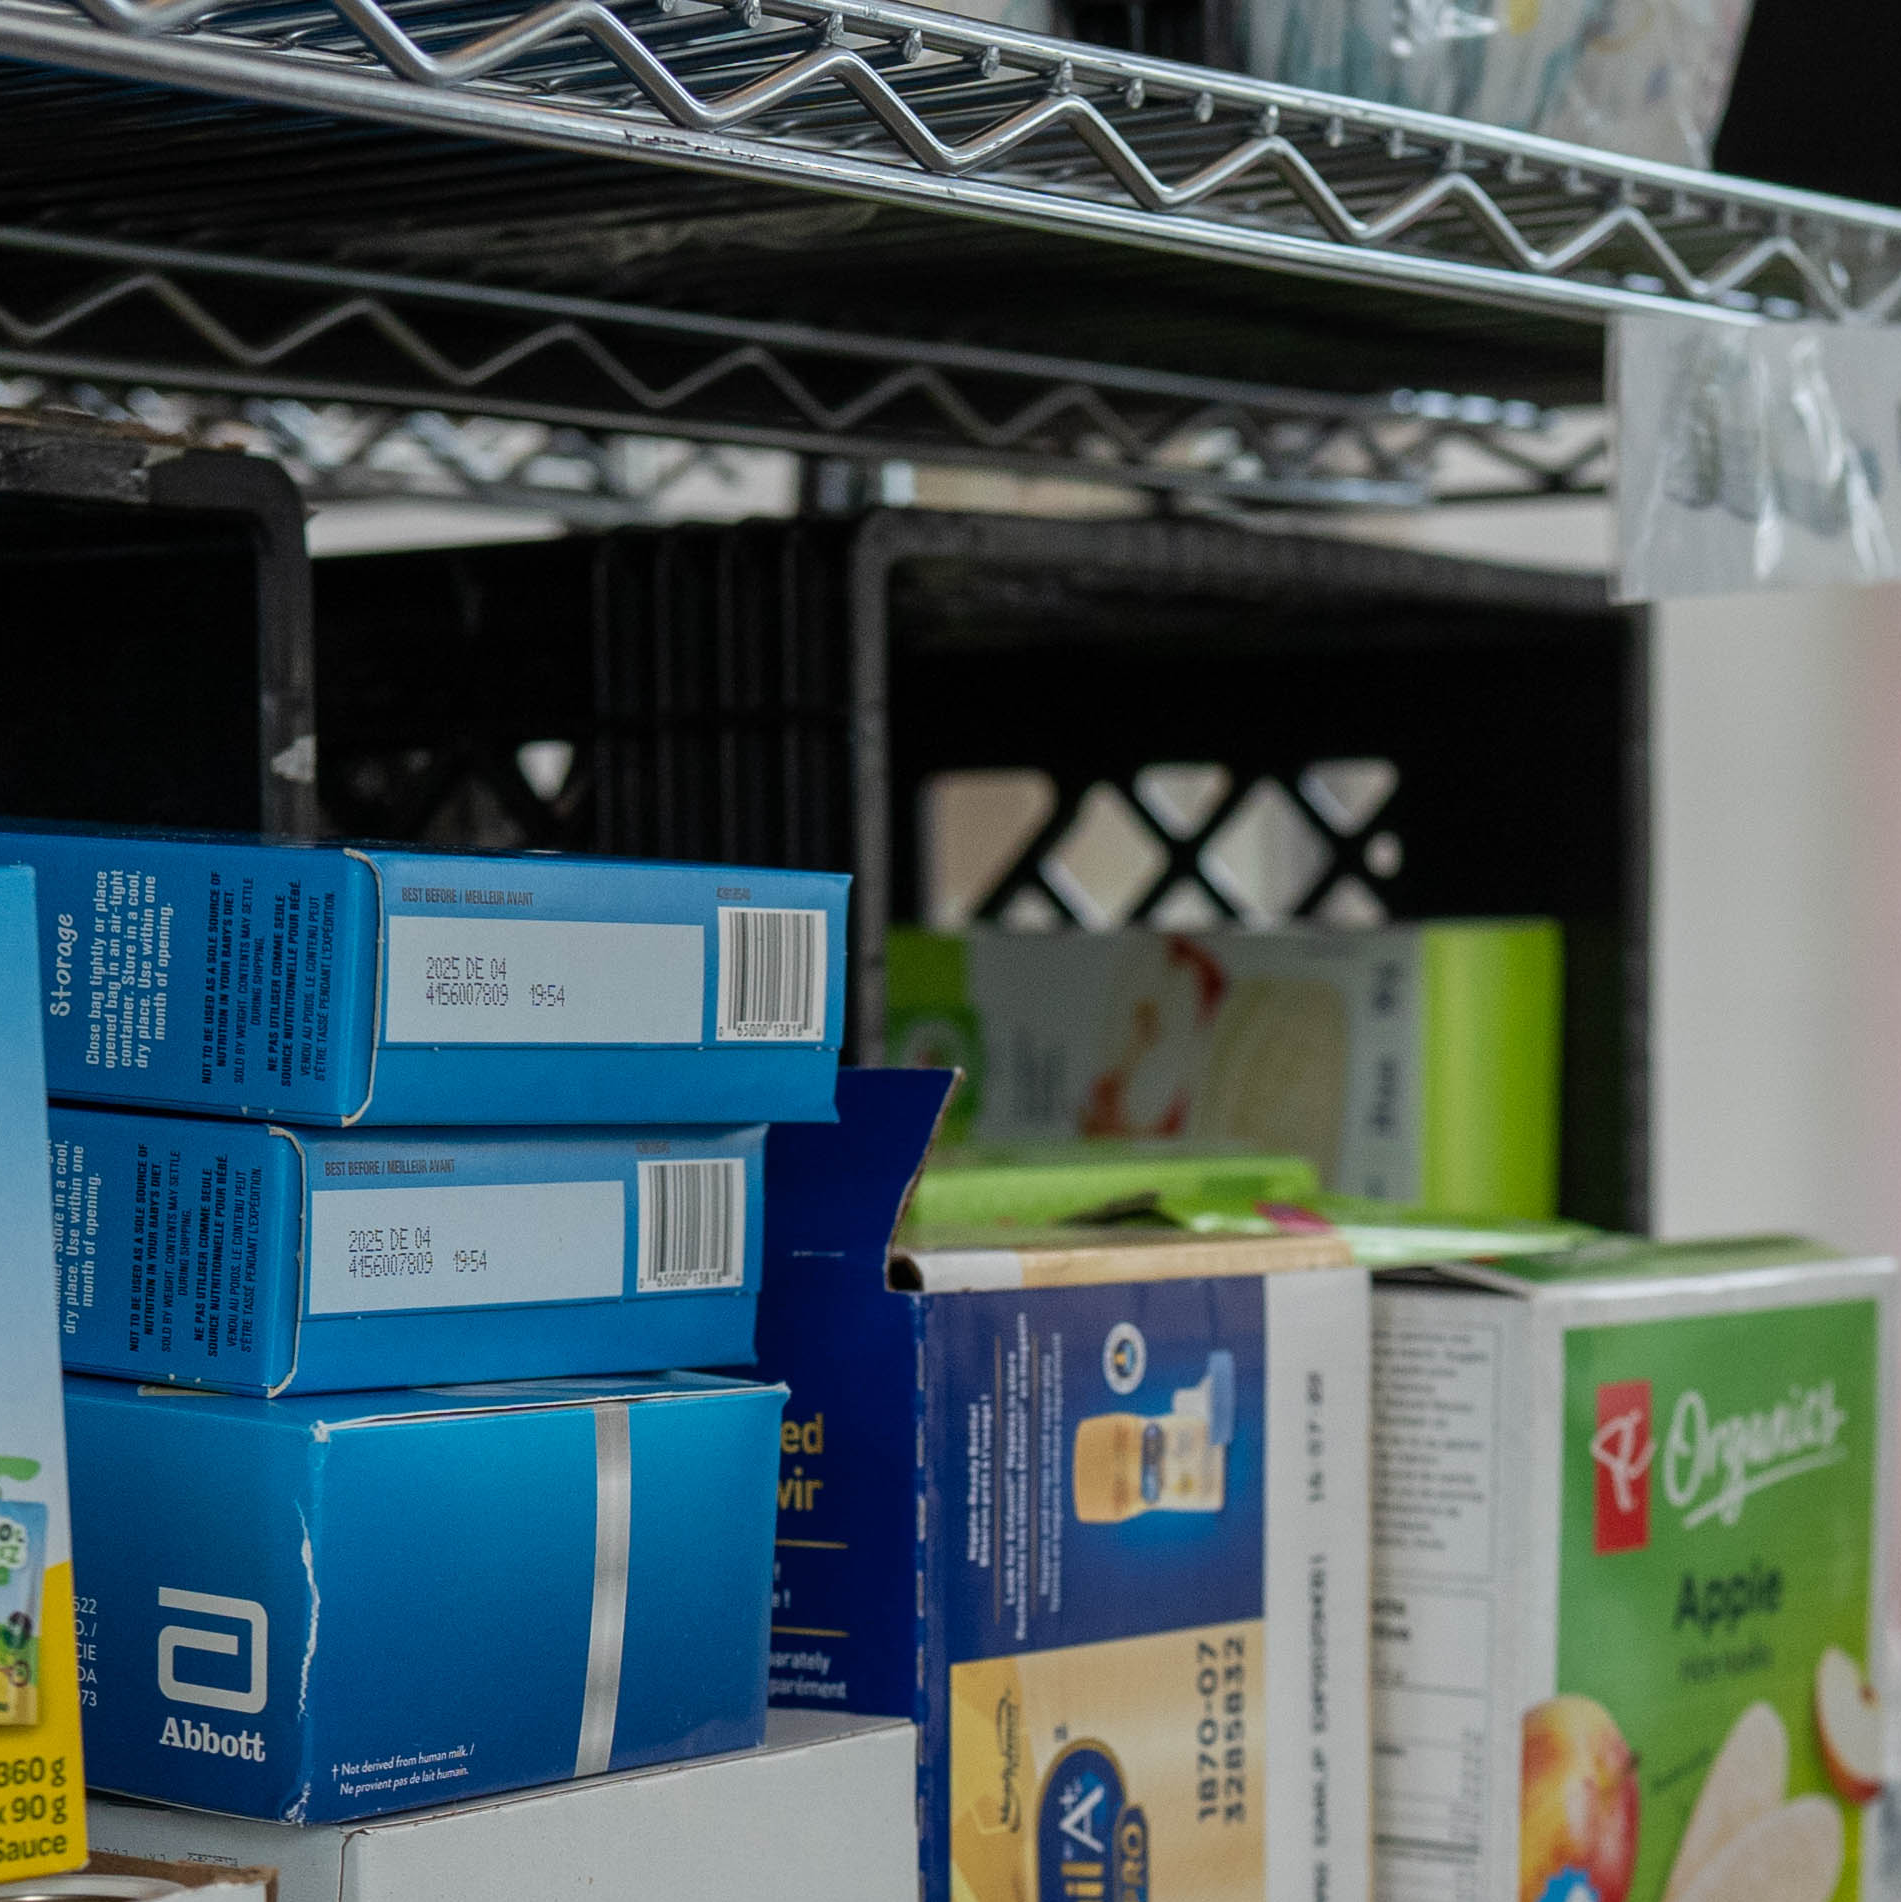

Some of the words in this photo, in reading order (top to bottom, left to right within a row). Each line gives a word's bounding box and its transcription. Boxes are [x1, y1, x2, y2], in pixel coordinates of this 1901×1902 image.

[94, 872, 107, 912] place
[127, 871, 140, 906] cool,
[145, 876, 155, 902] one
[211, 872, 220, 885] OF
[108, 870, 125, 933] air-tight
[208, 890, 219, 932] SOURCE
[223, 887, 234, 915] DIET.
[402, 888, 423, 903] BEST
[425, 888, 457, 904] BEFORE
[466, 888, 504, 905] MEILLEUR
[506, 890, 533, 906] AVANT
[95, 917, 104, 932] or
[128, 912, 138, 920] a
[124, 926, 137, 939] in
[141, 909, 154, 955] within
[158, 903, 173, 967] opening.
[222, 919, 232, 957] BABY'S
[90, 938, 106, 985] tightly
[110, 939, 120, 956] an
[207, 936, 217, 963] SOLE
[51, 914, 77, 1016] Storage
[108, 962, 119, 976] in
[123, 945, 136, 985] Store
[139, 961, 151, 988] Use
[155, 972, 167, 986] of
[220, 961, 230, 990] YOUR
[426, 956, 460, 981] 2025
[466, 957, 484, 980] DE
[490, 957, 507, 981] 04
[106, 982, 121, 1008] bag
[206, 978, 215, 992] AS
[219, 994, 229, 1005] IN
[426, 982, 508, 1006] 4156007809
[529, 984, 566, 1006] 19:54
[89, 992, 104, 1018] bag
[138, 995, 150, 1039] place.
[155, 993, 166, 1040] month
[204, 995, 214, 1024] USED
[105, 1014, 119, 1068] opened
[121, 992, 133, 1066] container.
[203, 1028, 213, 1042] BE
[217, 1009, 228, 1066] NUTRITION
[737, 1023, 767, 1037] 65000
[772, 1023, 803, 1038] 13818
[86, 1024, 100, 1064] Close
[136, 1044, 150, 1068] dry
[202, 1046, 212, 1058] TO
[202, 1063, 212, 1084] NOT
[325, 1161, 346, 1177] BEST
[348, 1160, 380, 1176] BEFORE
[388, 1160, 428, 1176] MEILLEUR
[429, 1158, 455, 1174] AVANT
[349, 1229, 385, 1253] 2025
[390, 1228, 408, 1251] DE
[414, 1226, 431, 1249] 04
[1662, 1380, 1848, 1525] Organics
[1672, 1563, 1784, 1636] Apple
[159, 1715, 266, 1763] Abbott
[1197, 1641, 1219, 1822] 1870-07
[51, 1757, 66, 1787] g
[341, 1761, 360, 1777] Not
[362, 1757, 394, 1775] derived
[396, 1755, 417, 1770] from
[418, 1752, 447, 1767] human
[448, 1747, 468, 1761] milk.
[340, 1782, 354, 1795] Ne
[355, 1777, 391, 1797] provient
[393, 1775, 408, 1790] pas
[410, 1771, 420, 1784] de
[421, 1769, 435, 1782] lait
[437, 1765, 469, 1780] humain.
[11, 1795, 46, 1823] 90
[51, 1795, 67, 1825] g
